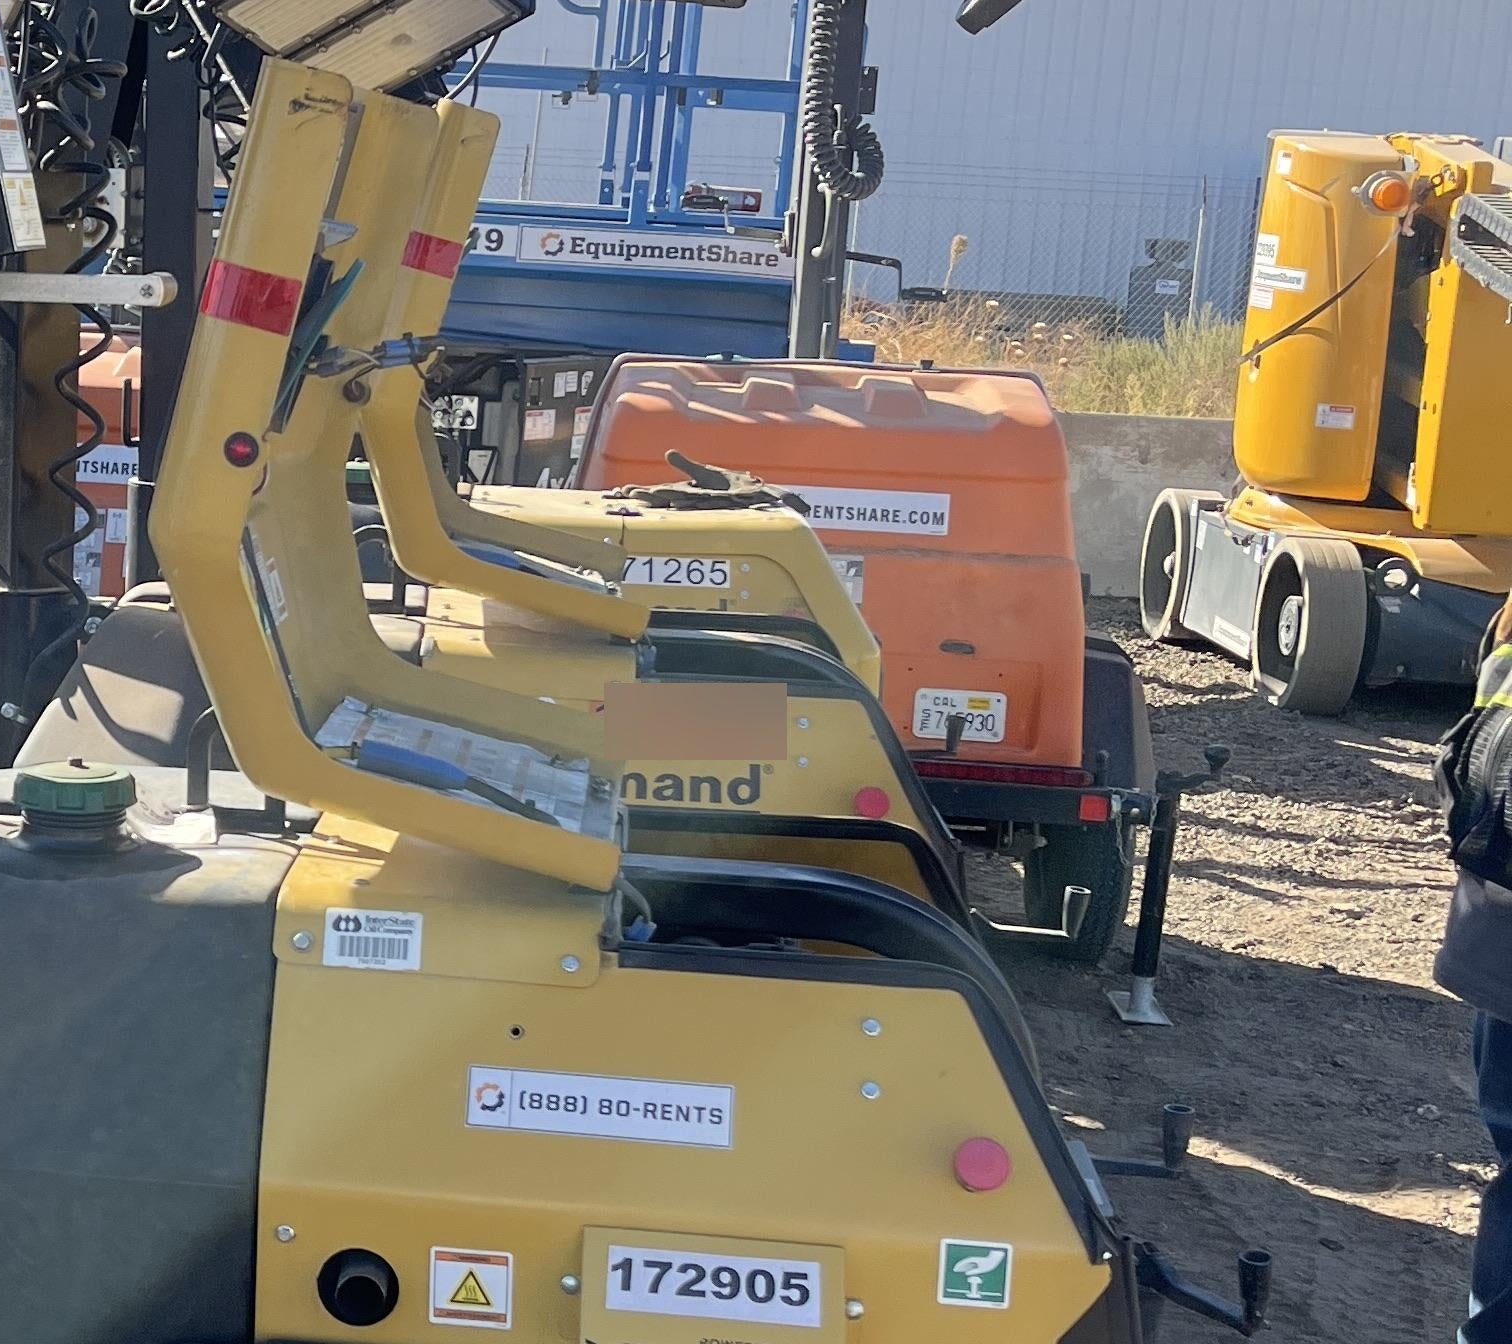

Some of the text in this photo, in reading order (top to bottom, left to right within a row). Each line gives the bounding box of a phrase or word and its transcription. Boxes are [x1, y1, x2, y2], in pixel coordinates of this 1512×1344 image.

[569, 236, 779, 268] EquipmentShare
[76, 460, 138, 477] TSHARE
[621, 556, 728, 586] 71265
[933, 696, 957, 708] CAL
[620, 763, 761, 806] mand
[519, 1090, 724, 1125] (888) 80-RENTS
[610, 1257, 811, 1307] 172905
